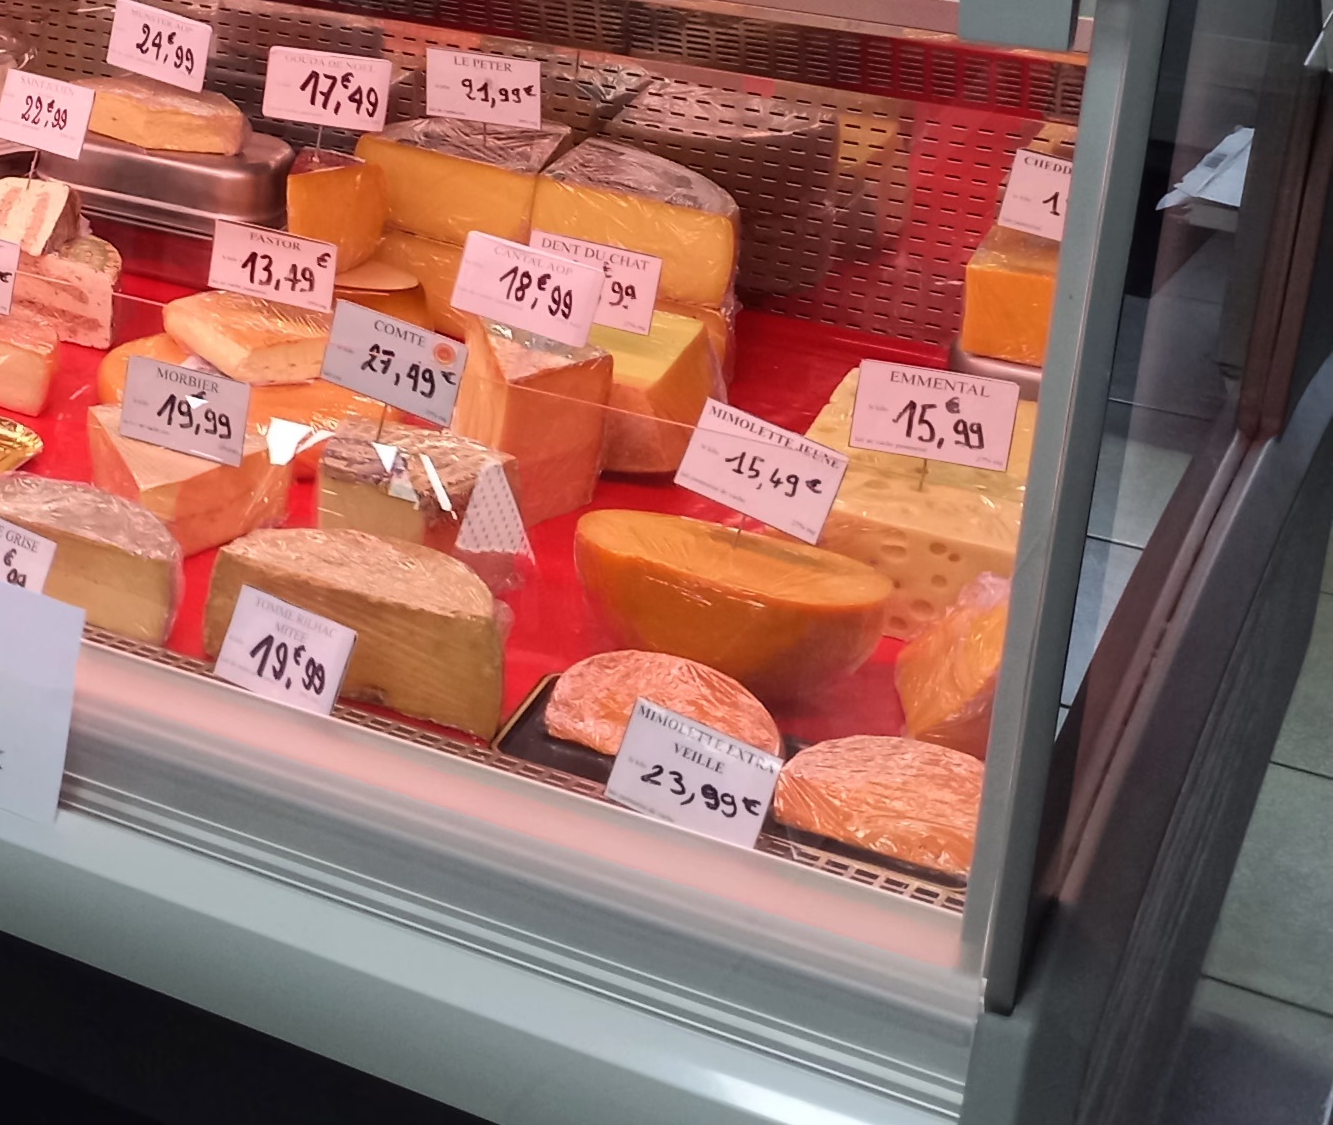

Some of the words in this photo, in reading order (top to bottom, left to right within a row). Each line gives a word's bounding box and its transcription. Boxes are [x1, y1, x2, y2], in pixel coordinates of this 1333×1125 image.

[283, 53, 325, 69] GOUDA
[326, 58, 342, 70] DE
[453, 55, 469, 67] LE
[472, 57, 513, 74] PETER
[248, 230, 302, 253] PASTOR
[493, 243, 545, 268] CANTAL
[541, 235, 582, 257] DENT
[583, 245, 606, 260] DU
[607, 247, 651, 272] CHAT
[373, 318, 426, 349] COMTE
[155, 366, 221, 394] MORBIER
[890, 369, 991, 399] EMMENTAL
[709, 405, 794, 449] MIMOLETTE
[790, 439, 841, 470] JEUNE
[4, 528, 39, 553] GRISE
[255, 596, 294, 620] TOMME
[637, 705, 725, 750] MIMOLETTE
[727, 743, 776, 774] EXTRA
[674, 743, 726, 774] VEILLE
